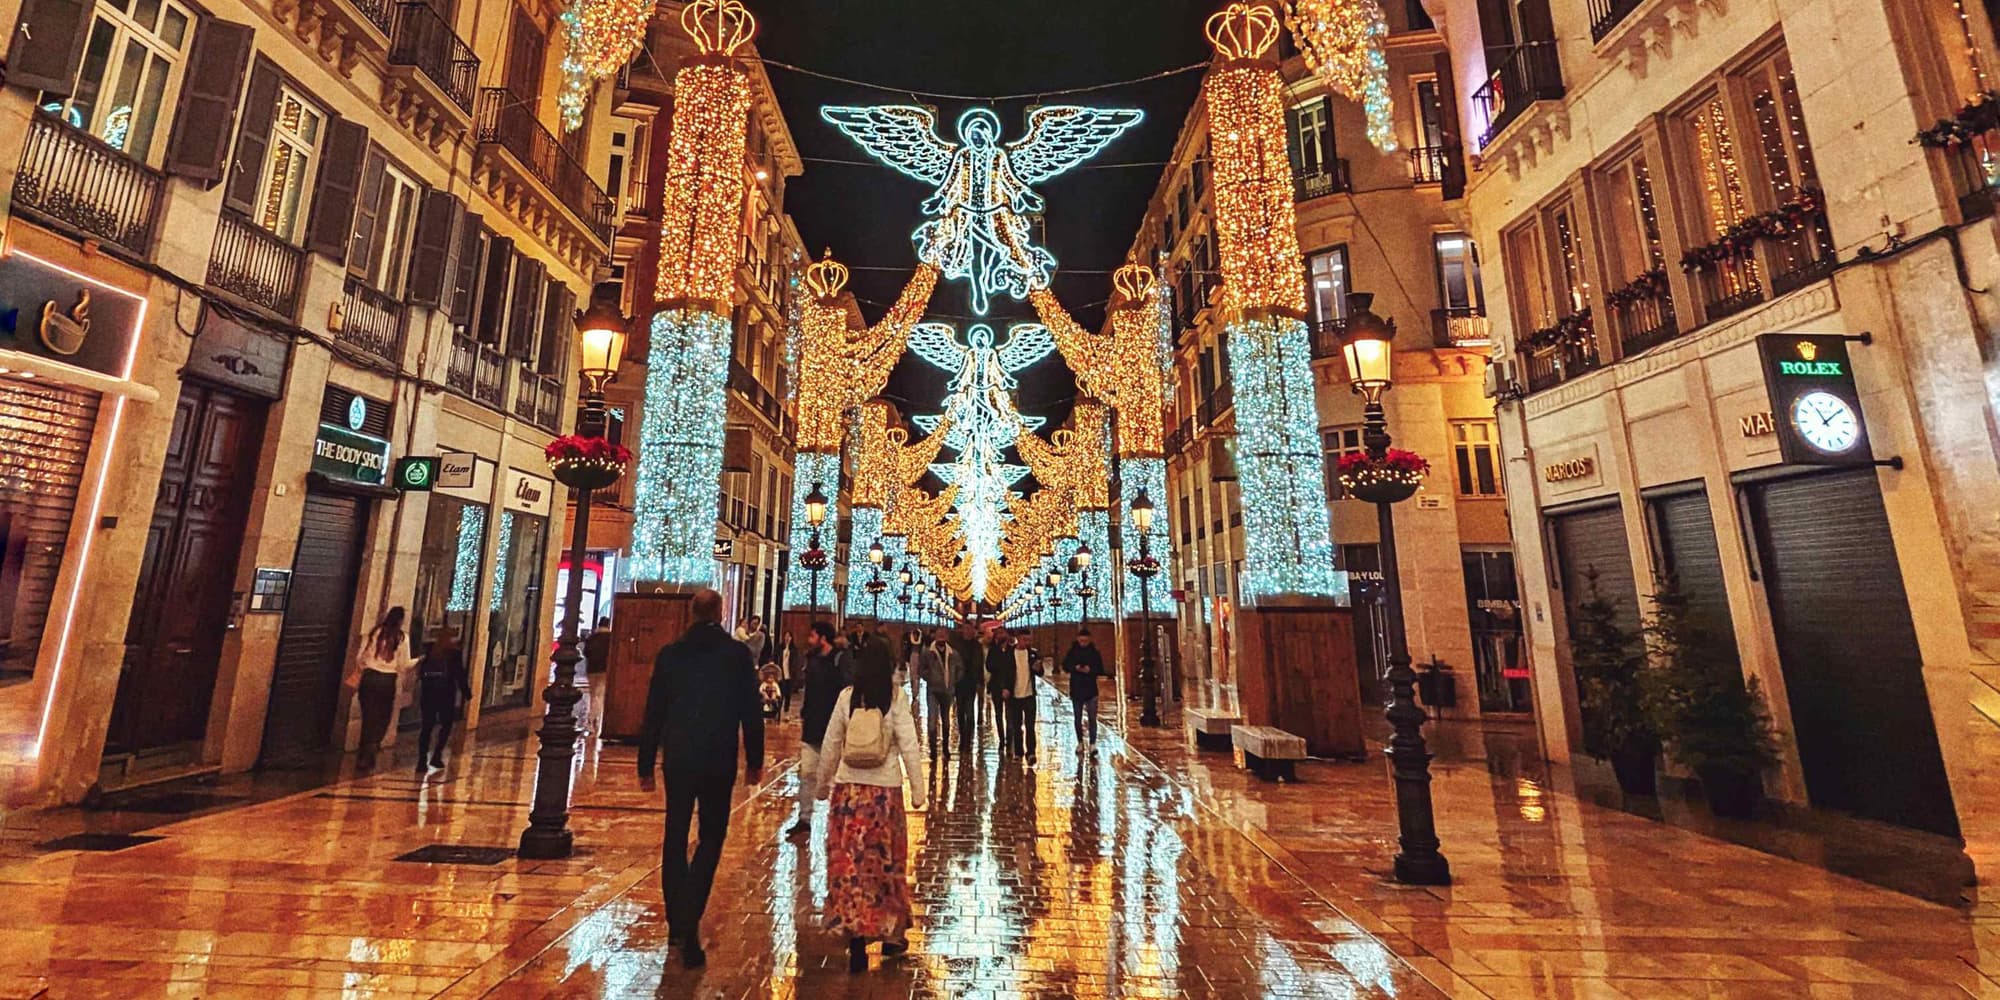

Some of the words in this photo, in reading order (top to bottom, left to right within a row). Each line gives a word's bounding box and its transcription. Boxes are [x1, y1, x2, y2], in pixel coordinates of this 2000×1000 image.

[1780, 361, 1843, 375] ROLEX
[316, 438, 336, 459] THE
[335, 444, 363, 465] BODY
[443, 463, 470, 473] Etam
[1544, 458, 1587, 481] MARCOS
[516, 477, 541, 503] Etam
[1368, 571, 1385, 580] LOL
